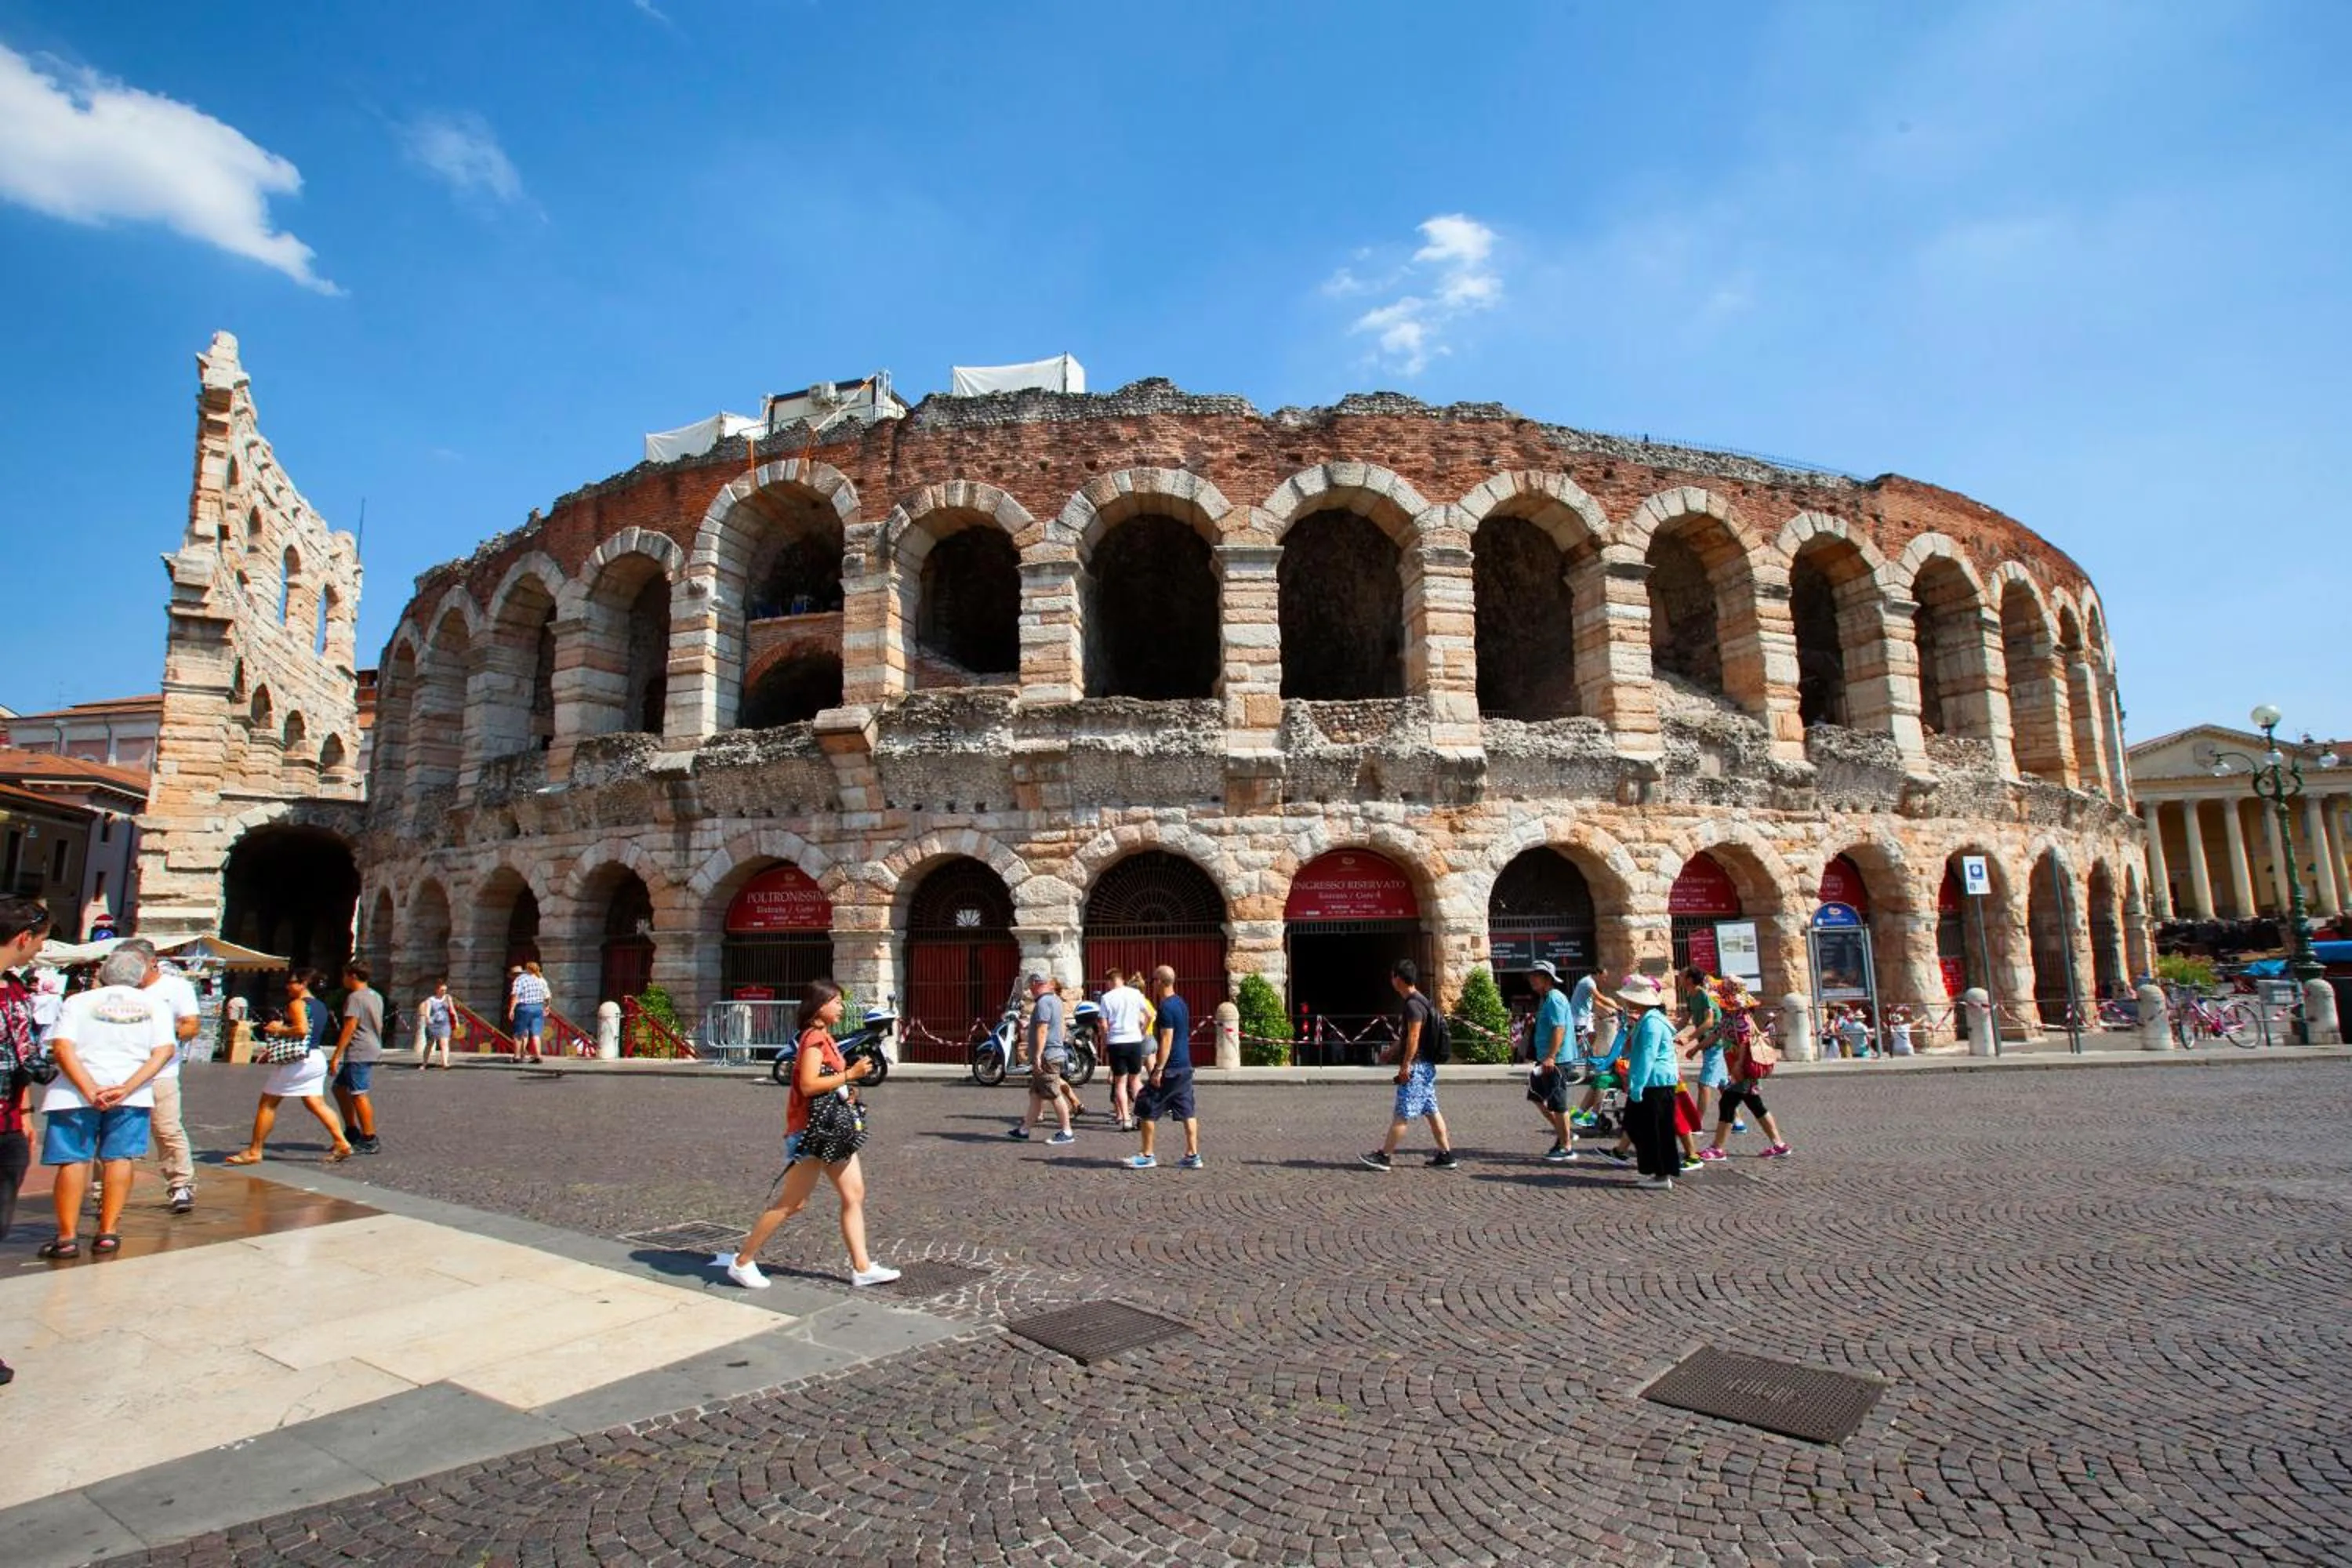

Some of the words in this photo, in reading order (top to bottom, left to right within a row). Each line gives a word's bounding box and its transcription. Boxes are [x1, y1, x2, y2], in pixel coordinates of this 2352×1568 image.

[1293, 880, 1345, 891] INGRESSO
[1347, 880, 1406, 890] RISERVATO
[747, 891, 828, 904] POLTRONISSIM
